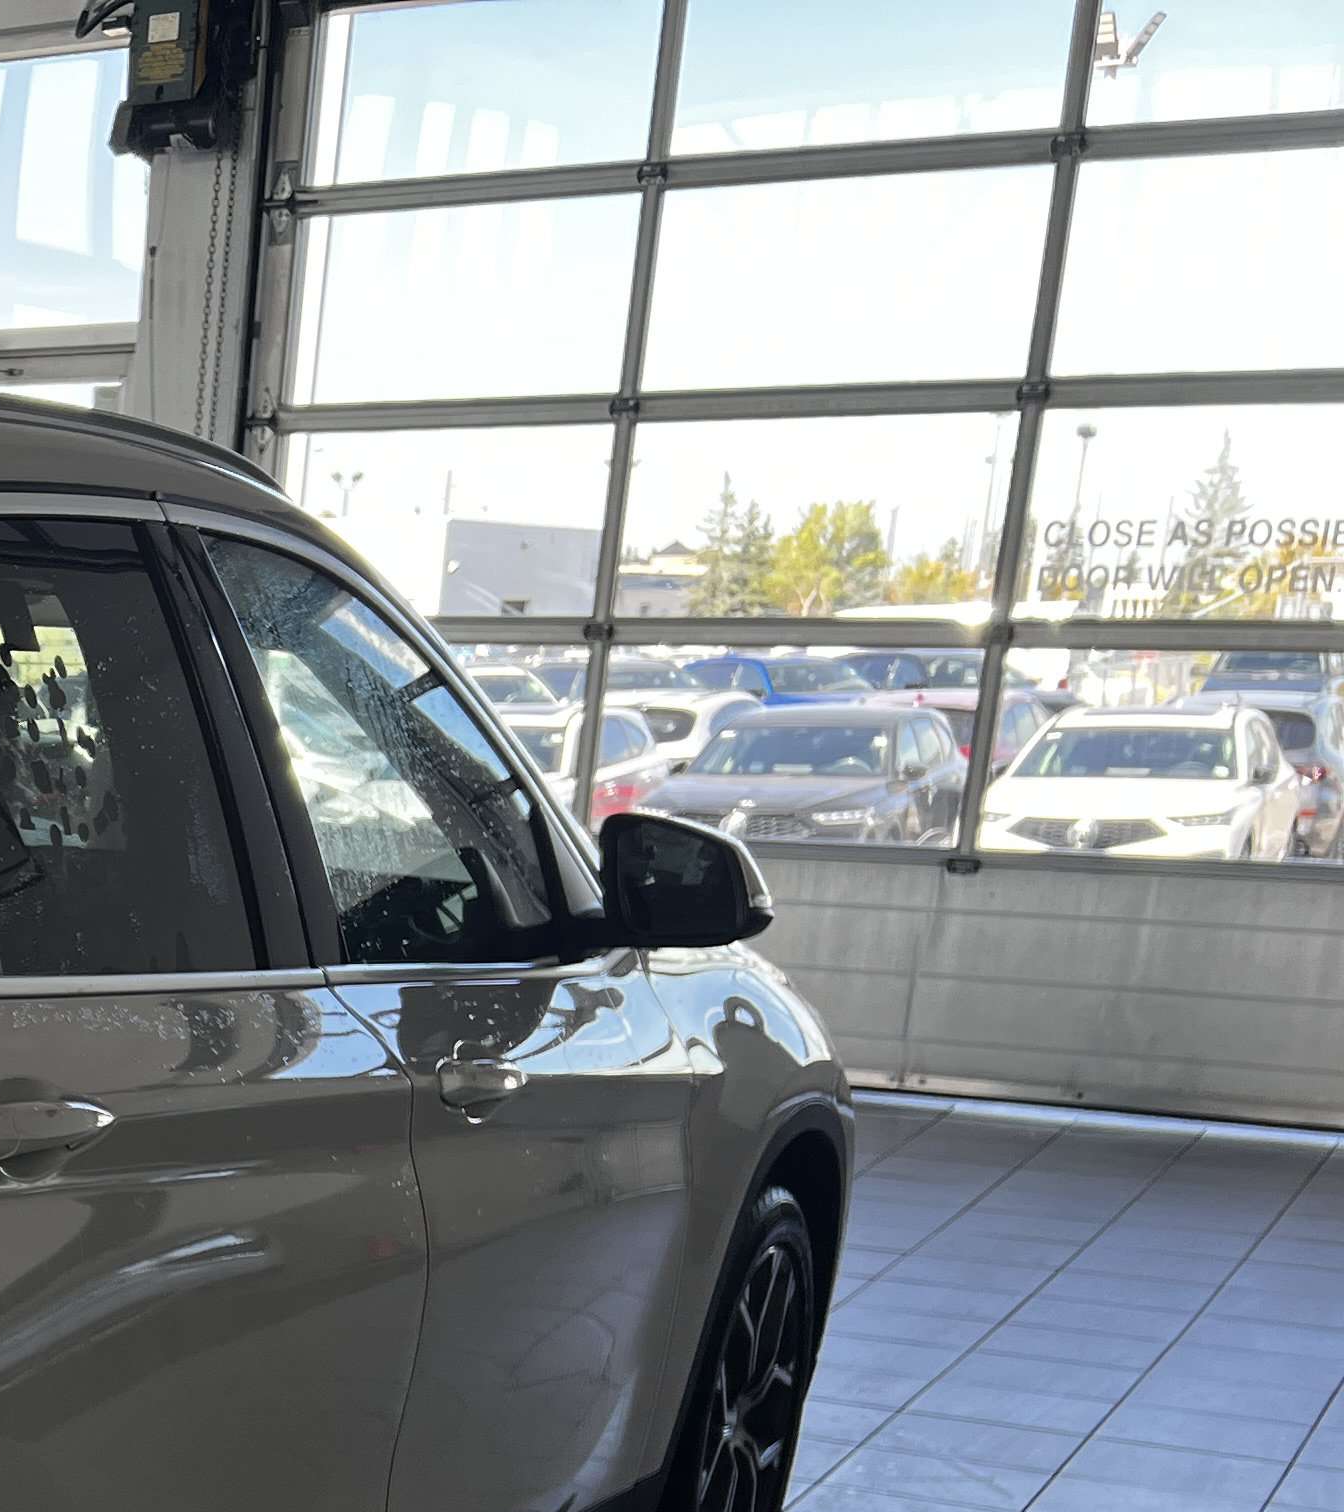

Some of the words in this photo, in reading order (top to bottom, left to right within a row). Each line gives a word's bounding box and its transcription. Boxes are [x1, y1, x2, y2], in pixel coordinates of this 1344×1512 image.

[1043, 519, 1157, 548] CLOSE
[1167, 519, 1213, 548] AS
[1037, 564, 1136, 592] DOOR
